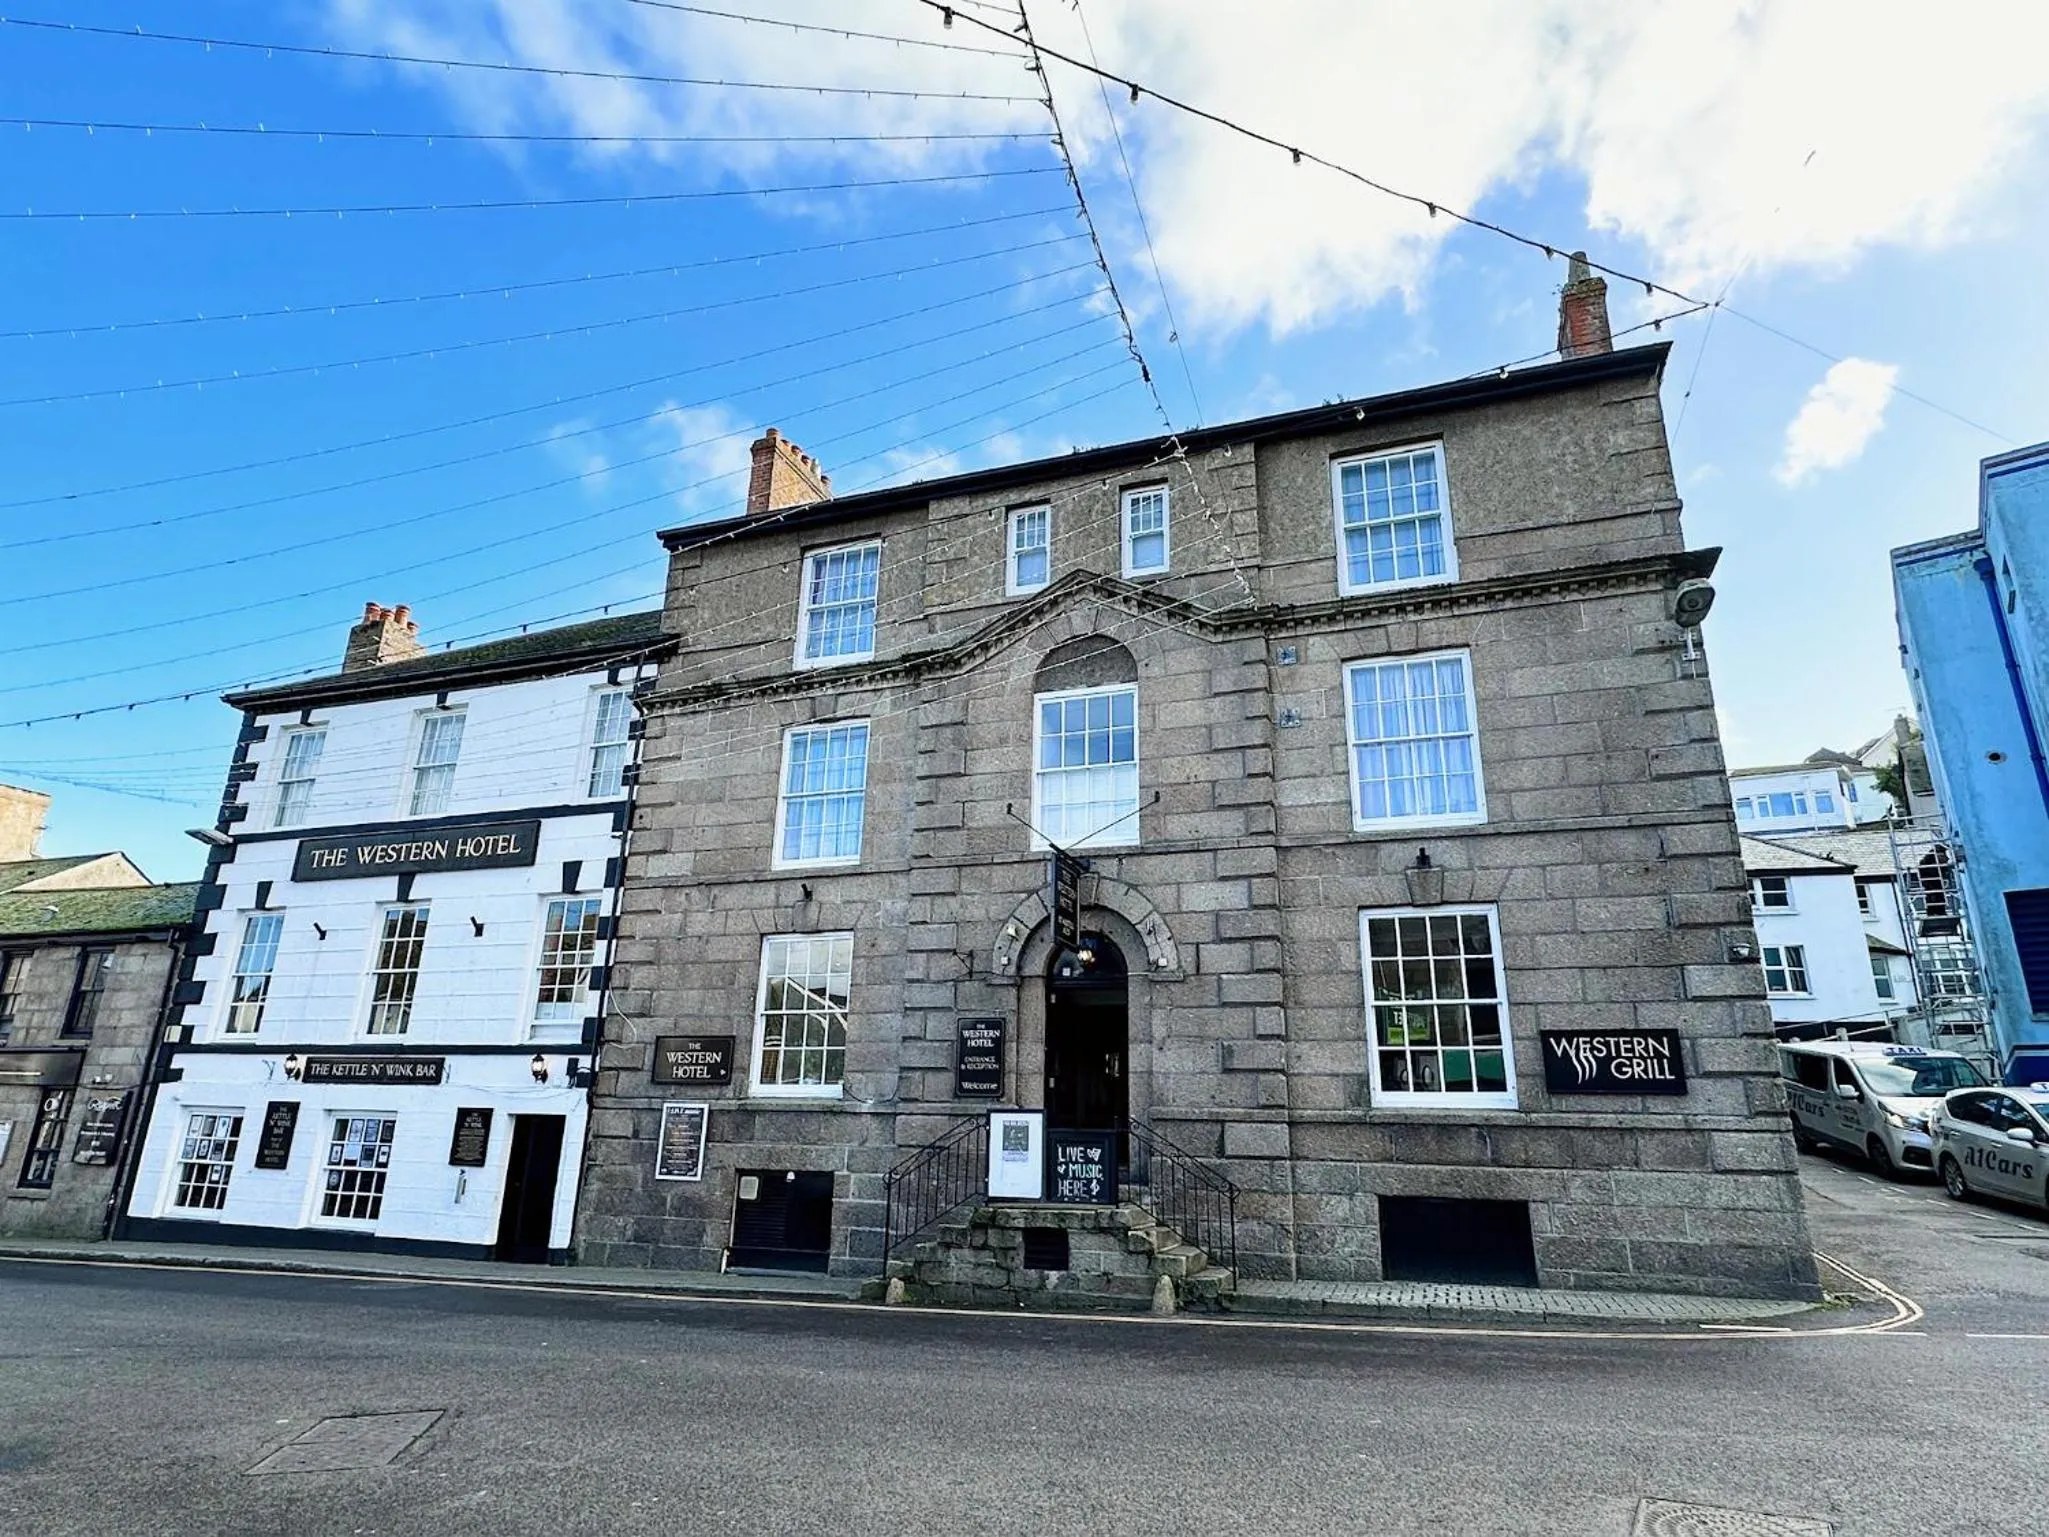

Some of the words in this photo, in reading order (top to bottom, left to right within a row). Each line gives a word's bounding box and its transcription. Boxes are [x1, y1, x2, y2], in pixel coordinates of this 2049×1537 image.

[311, 848, 348, 869] THE
[356, 840, 449, 865] WESTERN
[455, 833, 522, 858] HOTEL
[962, 1029, 1000, 1038] WESTERN
[688, 1042, 702, 1050] THE
[967, 1039, 995, 1048] HOTEL
[1549, 1036, 1671, 1063] WESTERN
[665, 1051, 722, 1064] WESTERN
[310, 1063, 330, 1076] THE
[331, 1063, 369, 1076] KETTLE
[386, 1063, 414, 1077] WINK
[416, 1063, 437, 1077] BAR
[672, 1065, 712, 1078] HOTEL
[1611, 1058, 1676, 1079] GRILL
[961, 1081, 998, 1090] Welcome
[1057, 1144, 1085, 1163] LIVE
[1964, 1146, 2034, 1179] A1Cars
[1068, 1163, 1103, 1179] MUSIC
[1057, 1178, 1089, 1198] HERE
